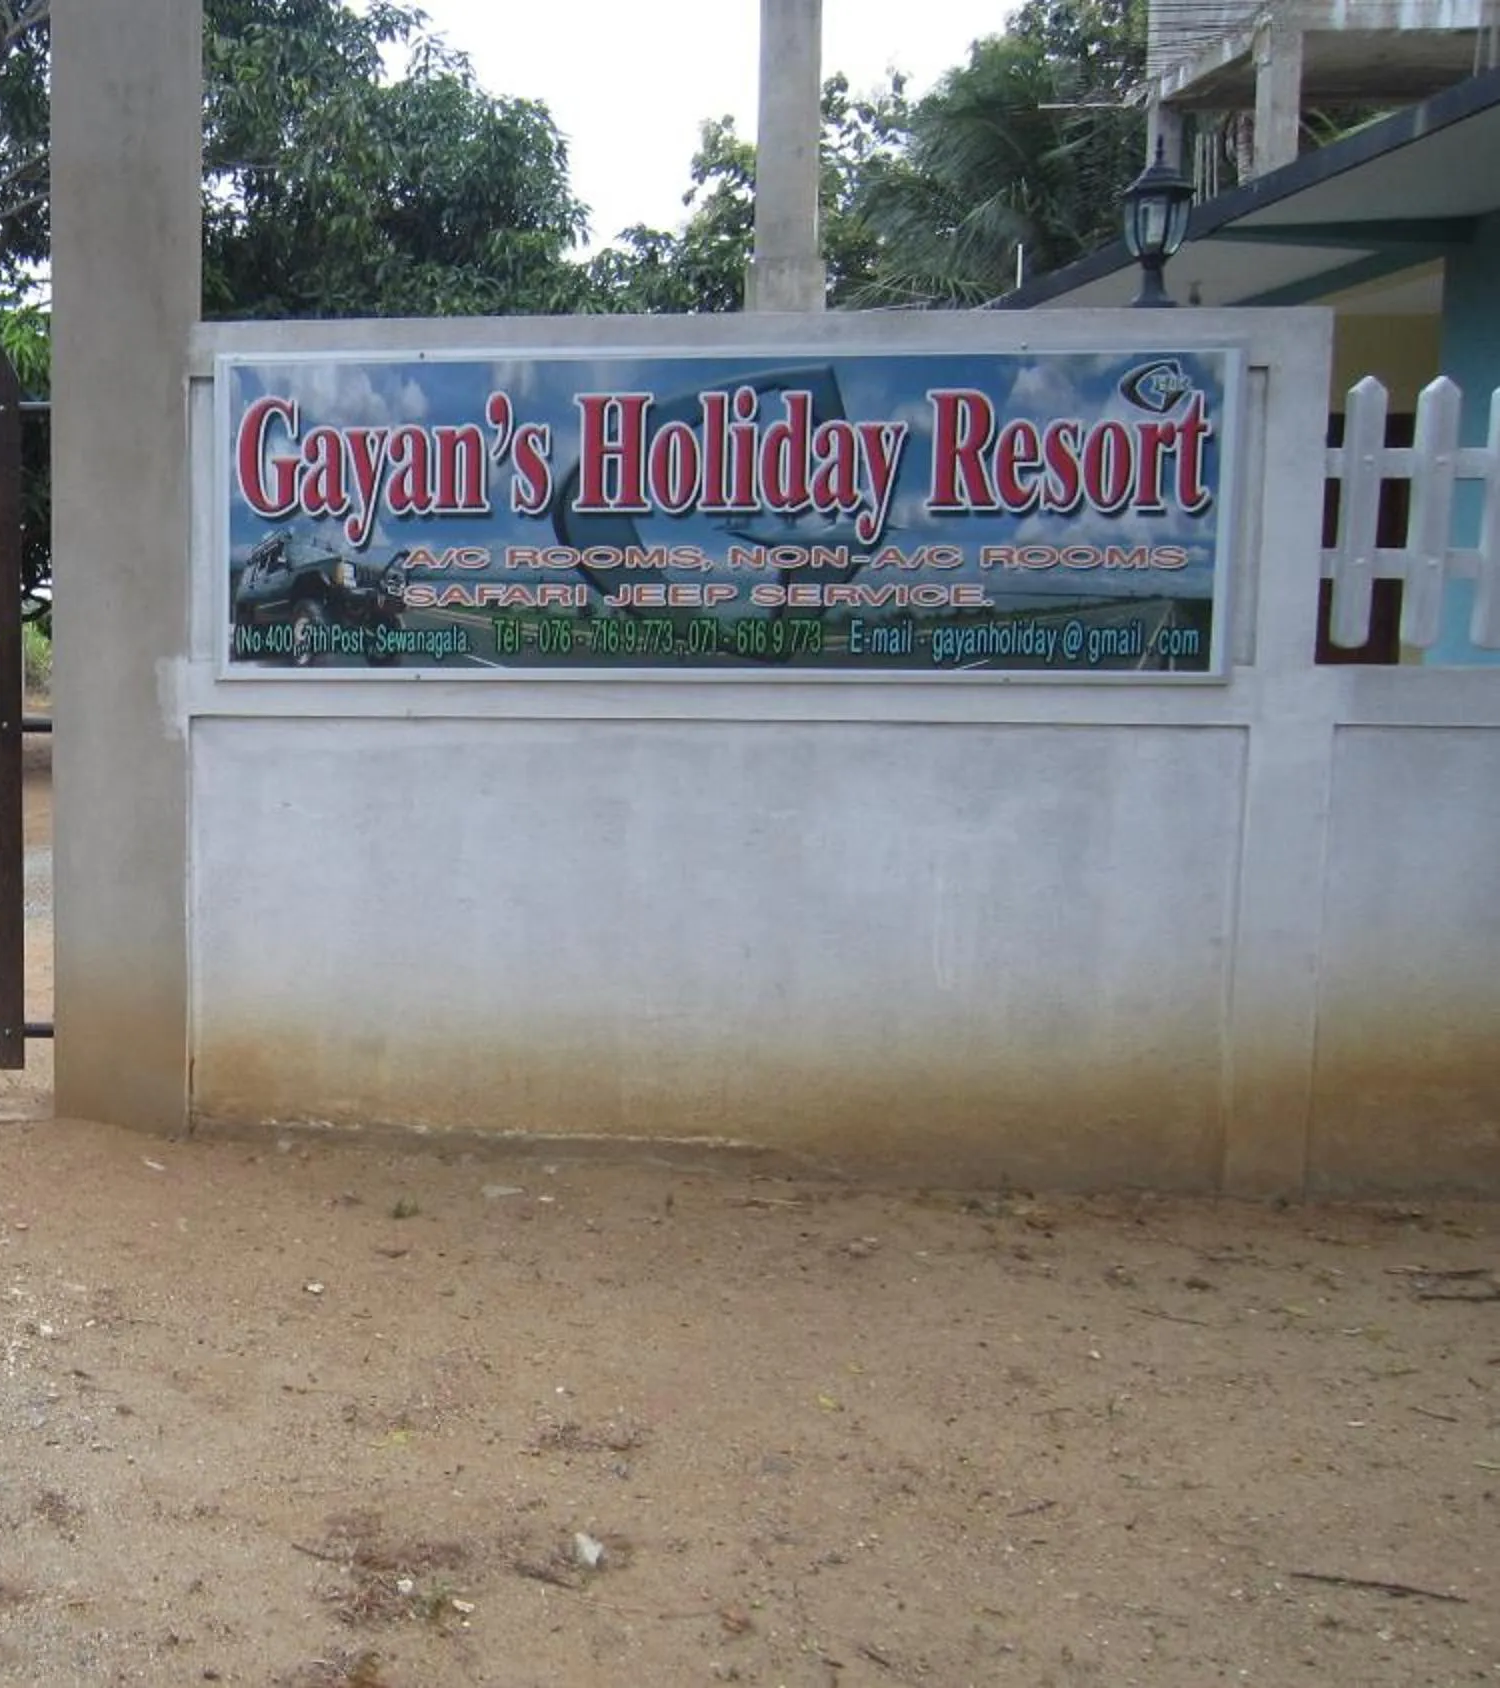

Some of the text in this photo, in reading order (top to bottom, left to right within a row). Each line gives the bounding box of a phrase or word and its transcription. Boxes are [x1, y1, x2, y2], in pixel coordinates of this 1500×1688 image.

[236, 386, 1212, 545] Gayan's Holiday Resort
[403, 545, 1188, 571] A/C ROOMS, NON-A/C ROOMS
[403, 583, 994, 608] SAFARI JEEP SERVICE.
[493, 619, 519, 652] Tel
[538, 619, 571, 652] 076
[591, 619, 619, 652] 716
[737, 619, 766, 652] 616
[791, 619, 822, 652] 773
[851, 619, 913, 653] E-mail
[932, 620, 1057, 661] gayanholiday
